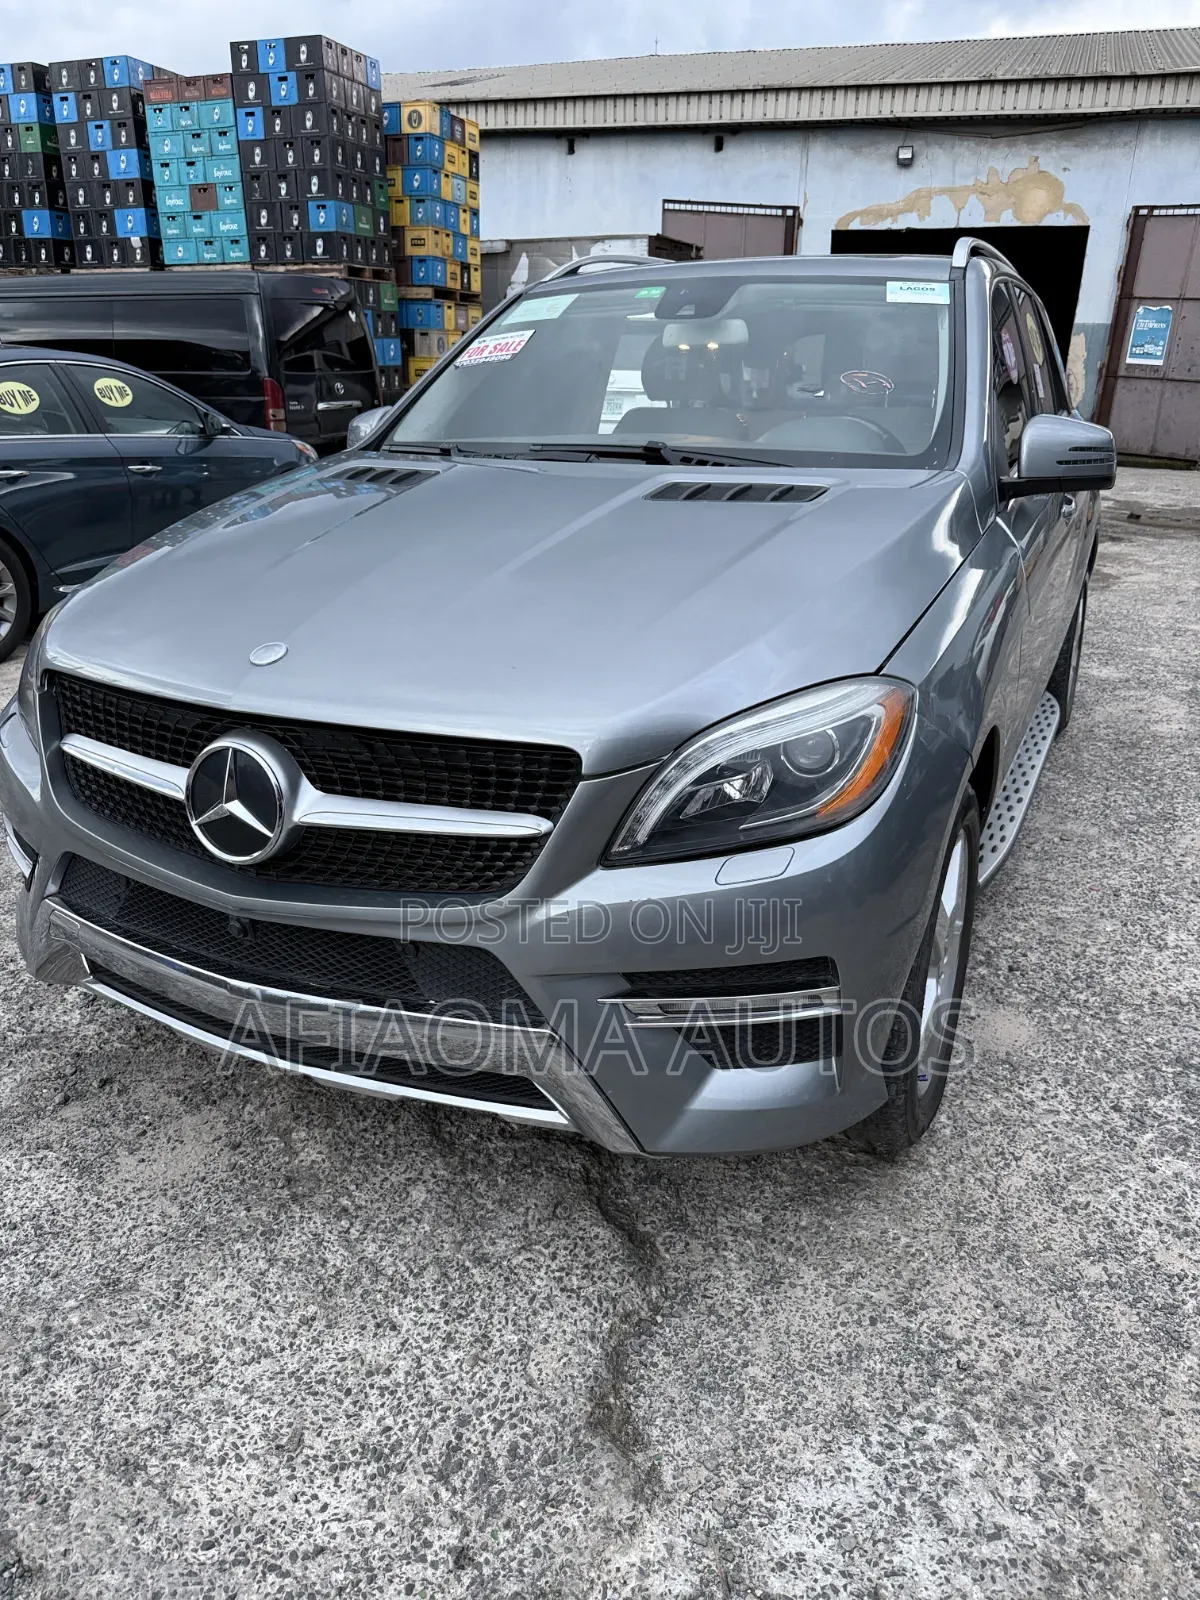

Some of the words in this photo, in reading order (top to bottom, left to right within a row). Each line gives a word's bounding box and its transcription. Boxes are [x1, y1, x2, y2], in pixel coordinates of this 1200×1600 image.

[460, 344, 490, 360] FOR
[488, 339, 527, 355] SALE
[17, 389, 36, 408] ME
[96, 384, 118, 403] BUY
[113, 384, 130, 401] ME
